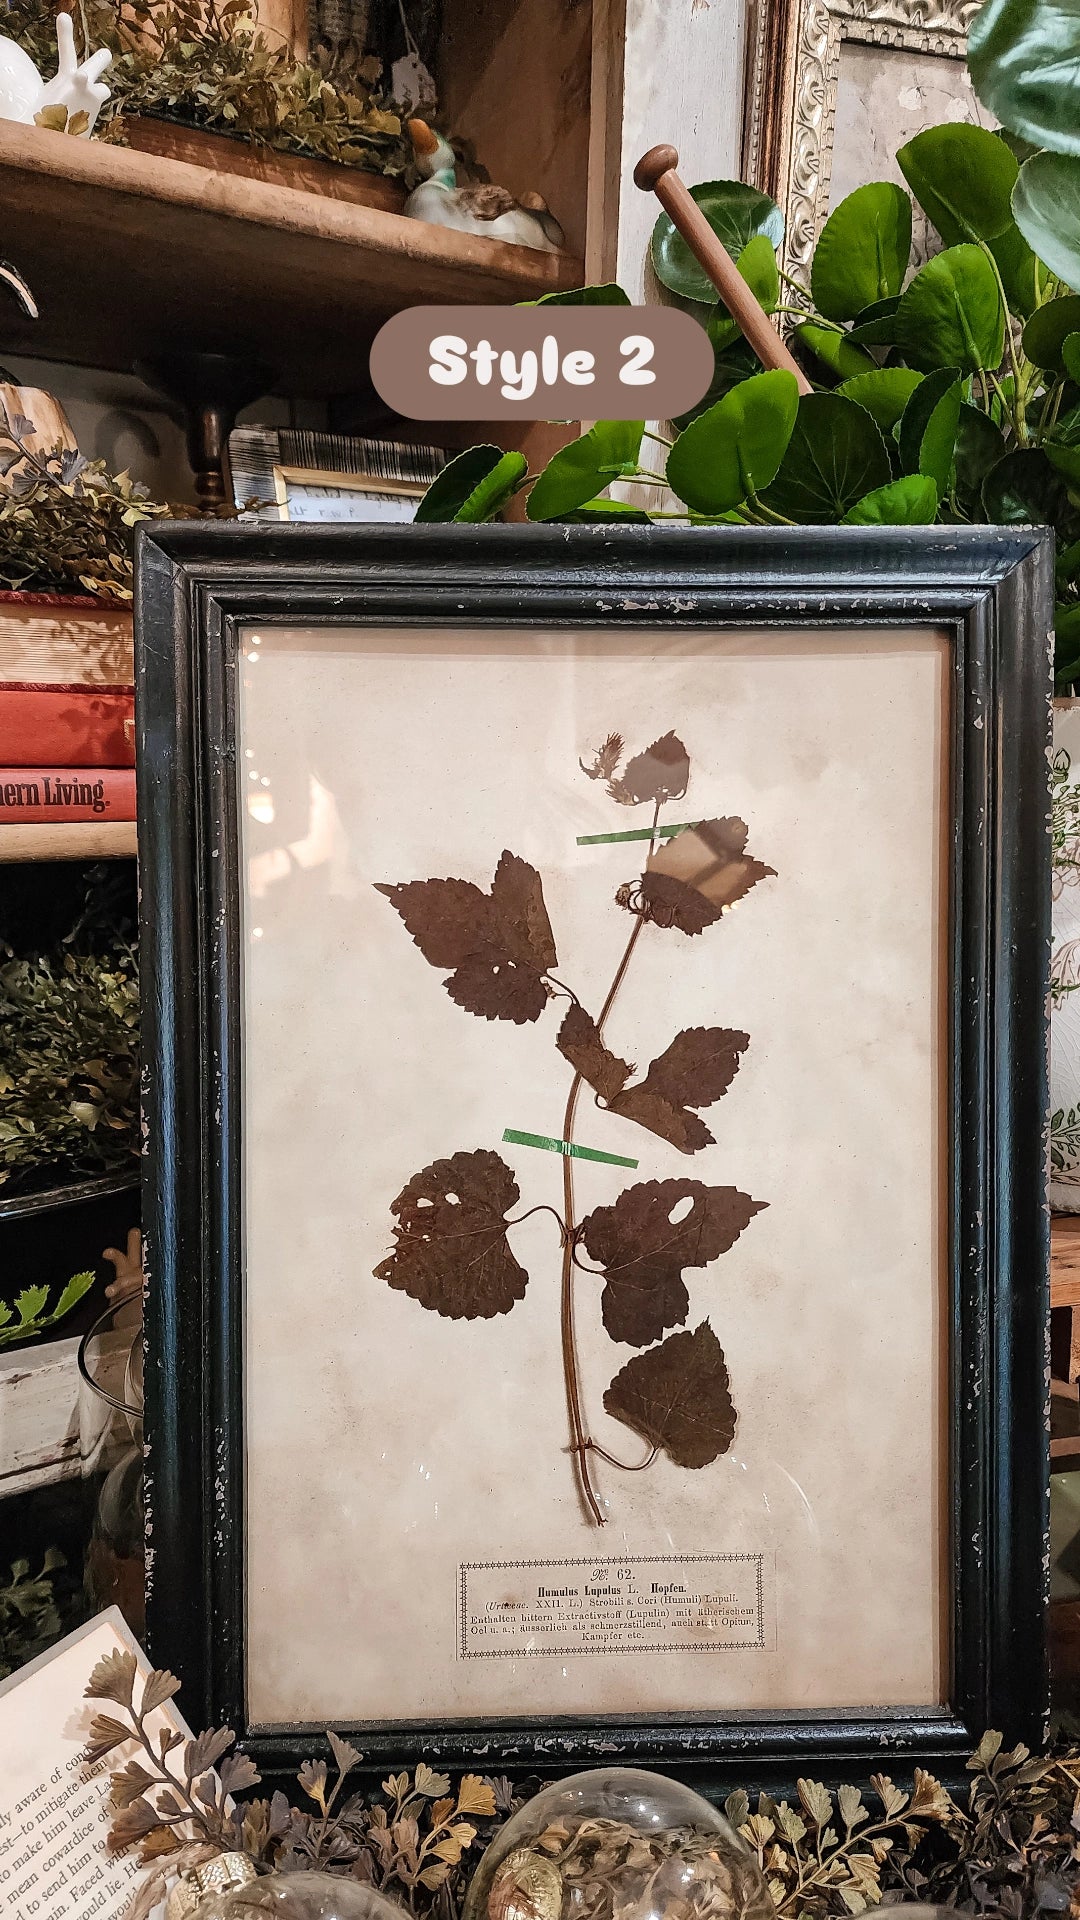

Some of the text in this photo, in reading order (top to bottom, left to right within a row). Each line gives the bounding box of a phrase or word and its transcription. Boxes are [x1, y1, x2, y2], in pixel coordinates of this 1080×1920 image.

[538, 1583, 687, 1598] Humulus Lupulus L. Hopfen.
[617, 1569, 636, 1581] 62.
[470, 1615, 517, 1625] Enthalten
[521, 1613, 553, 1622] bittern
[558, 1610, 622, 1622] Extractivstoff
[625, 1608, 670, 1620] (Lupulin)
[676, 1608, 692, 1617] mit
[569, 1598, 583, 1609] L.)
[589, 1597, 624, 1606] Strobili
[660, 1595, 702, 1607] (Humuli)
[705, 1594, 739, 1605] Lupuli.
[470, 1626, 487, 1635] Oel
[572, 1622, 586, 1631] als
[590, 1619, 666, 1631] schmerzstillend,
[671, 1619, 694, 1627] auch
[582, 1632, 623, 1643] Kampfer
[15, 1783, 47, 1814] aware
[50, 1767, 62, 1784] of
[65, 1744, 94, 1771] cond
[35, 1782, 79, 1823] mitigate
[79, 1759, 108, 1785] them
[12, 1841, 43, 1871] make
[42, 1820, 68, 1843] him
[65, 1795, 96, 1822] leave
[94, 1780, 113, 1798] La
[6, 1805, 109, 1904] mean cowardice of
[26, 1900, 40, 1915] to
[41, 1870, 69, 1901] send
[66, 1852, 93, 1877] him
[92, 1839, 106, 1854] to
[69, 1865, 105, 1904] Faced
[104, 1879, 125, 1897] lie.
[123, 1859, 143, 1880] He
